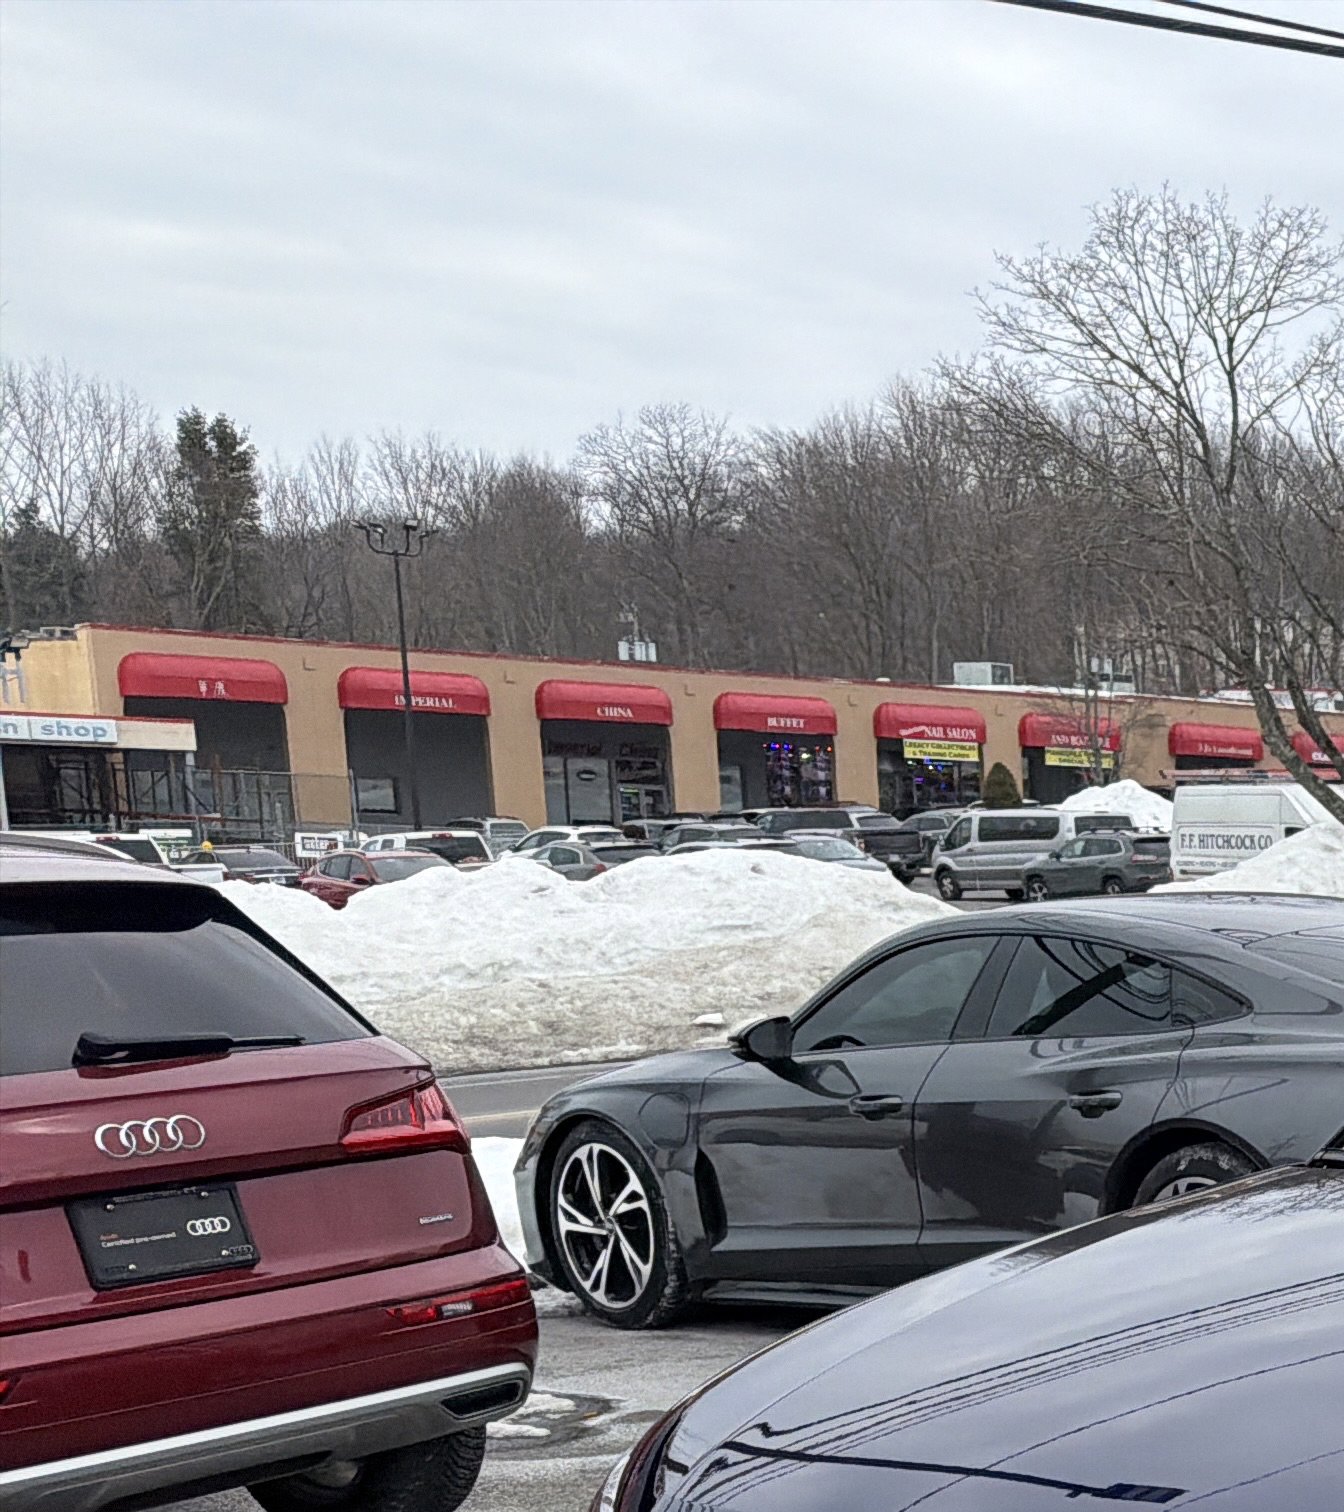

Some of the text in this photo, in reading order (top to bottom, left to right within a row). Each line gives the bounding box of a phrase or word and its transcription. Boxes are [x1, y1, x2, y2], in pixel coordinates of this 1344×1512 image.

[597, 706, 633, 718] CHINA
[767, 716, 805, 729] BUFFET
[40, 719, 108, 741] shop
[924, 726, 945, 739] NAIL
[946, 727, 977, 740] SALON
[1198, 833, 1256, 850] HITCHCOCK
[101, 1237, 134, 1248] Certified
